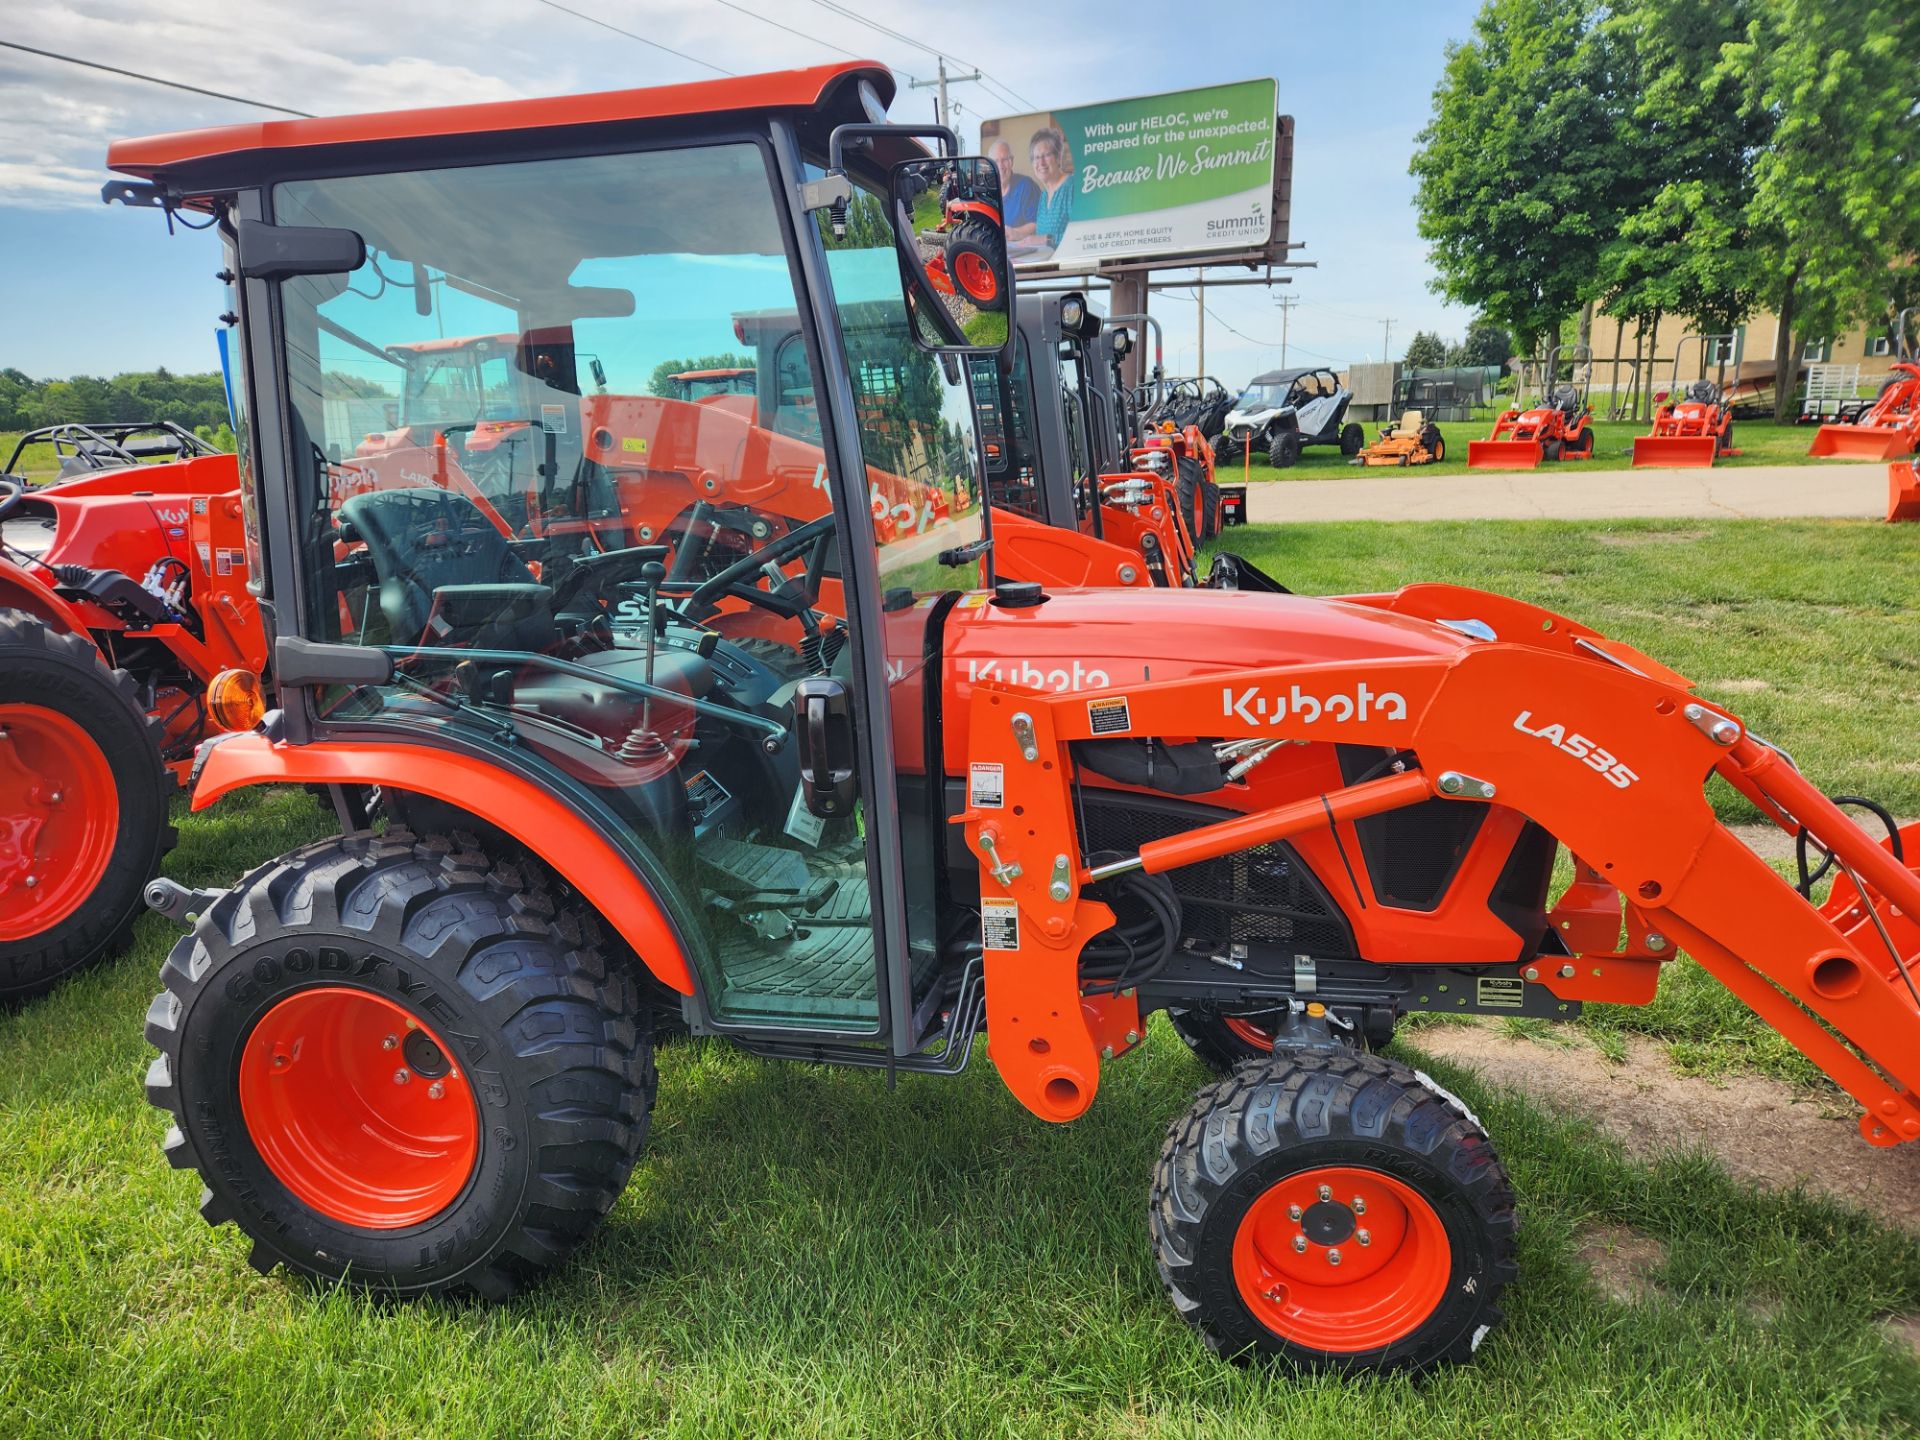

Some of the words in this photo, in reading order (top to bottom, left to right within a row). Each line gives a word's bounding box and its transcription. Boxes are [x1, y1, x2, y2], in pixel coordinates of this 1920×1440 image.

[1084, 123, 1114, 138] With
[1117, 121, 1138, 133] our
[1141, 112, 1189, 130] HELOC,
[1193, 108, 1229, 123] we're
[1084, 134, 1140, 156] prepared
[1143, 132, 1161, 145] for
[1164, 129, 1185, 142] the
[1188, 117, 1270, 139] unexpected.
[1082, 164, 1154, 194] Because
[1156, 152, 1189, 181] We
[1190, 137, 1272, 176] Summit
[1082, 233, 1096, 242] SUE
[1123, 227, 1144, 238] HOME
[1146, 226, 1173, 236] EQUITY
[1206, 230, 1235, 239] CREDIT
[1238, 226, 1265, 236] UNION
[1207, 212, 1265, 231] summit
[1082, 241, 1098, 251] LINE
[1099, 240, 1109, 249] OF
[1110, 237, 1136, 248] CREDIT
[1137, 235, 1172, 246] MEMBERS
[1223, 682, 1407, 726] Kubota
[1513, 710, 1640, 788] LA535
